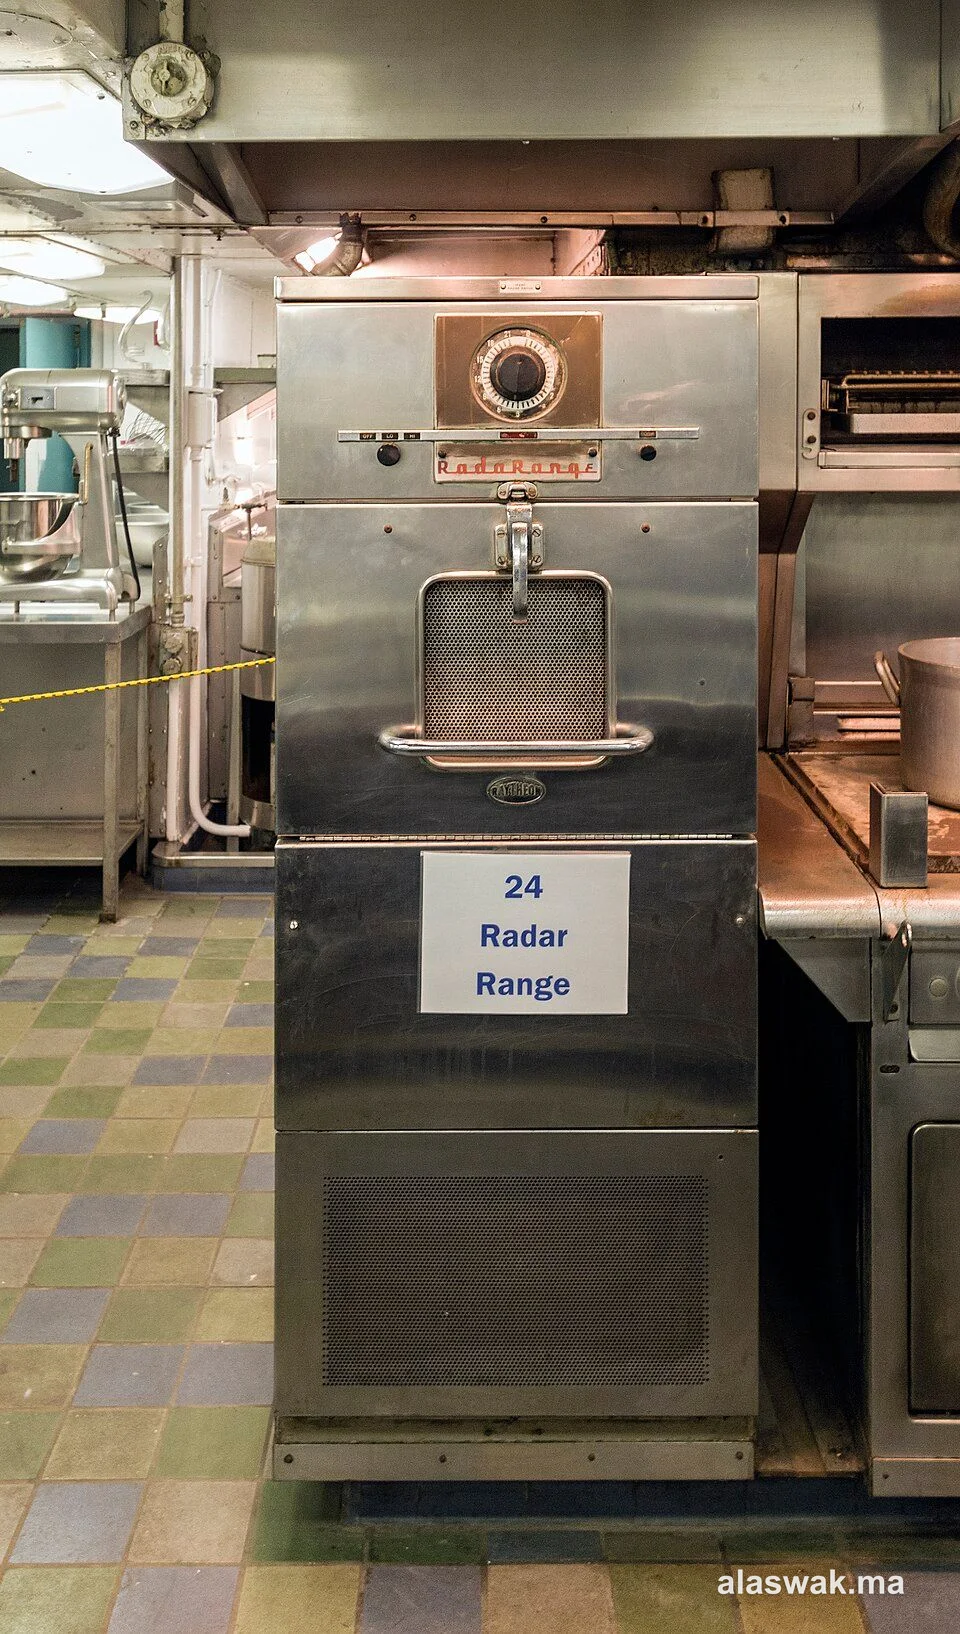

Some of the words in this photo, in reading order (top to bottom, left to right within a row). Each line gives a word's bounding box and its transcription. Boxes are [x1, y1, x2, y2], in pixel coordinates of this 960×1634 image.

[504, 874, 544, 899] 24
[480, 923, 568, 948] Radar
[476, 971, 571, 1001] Range
